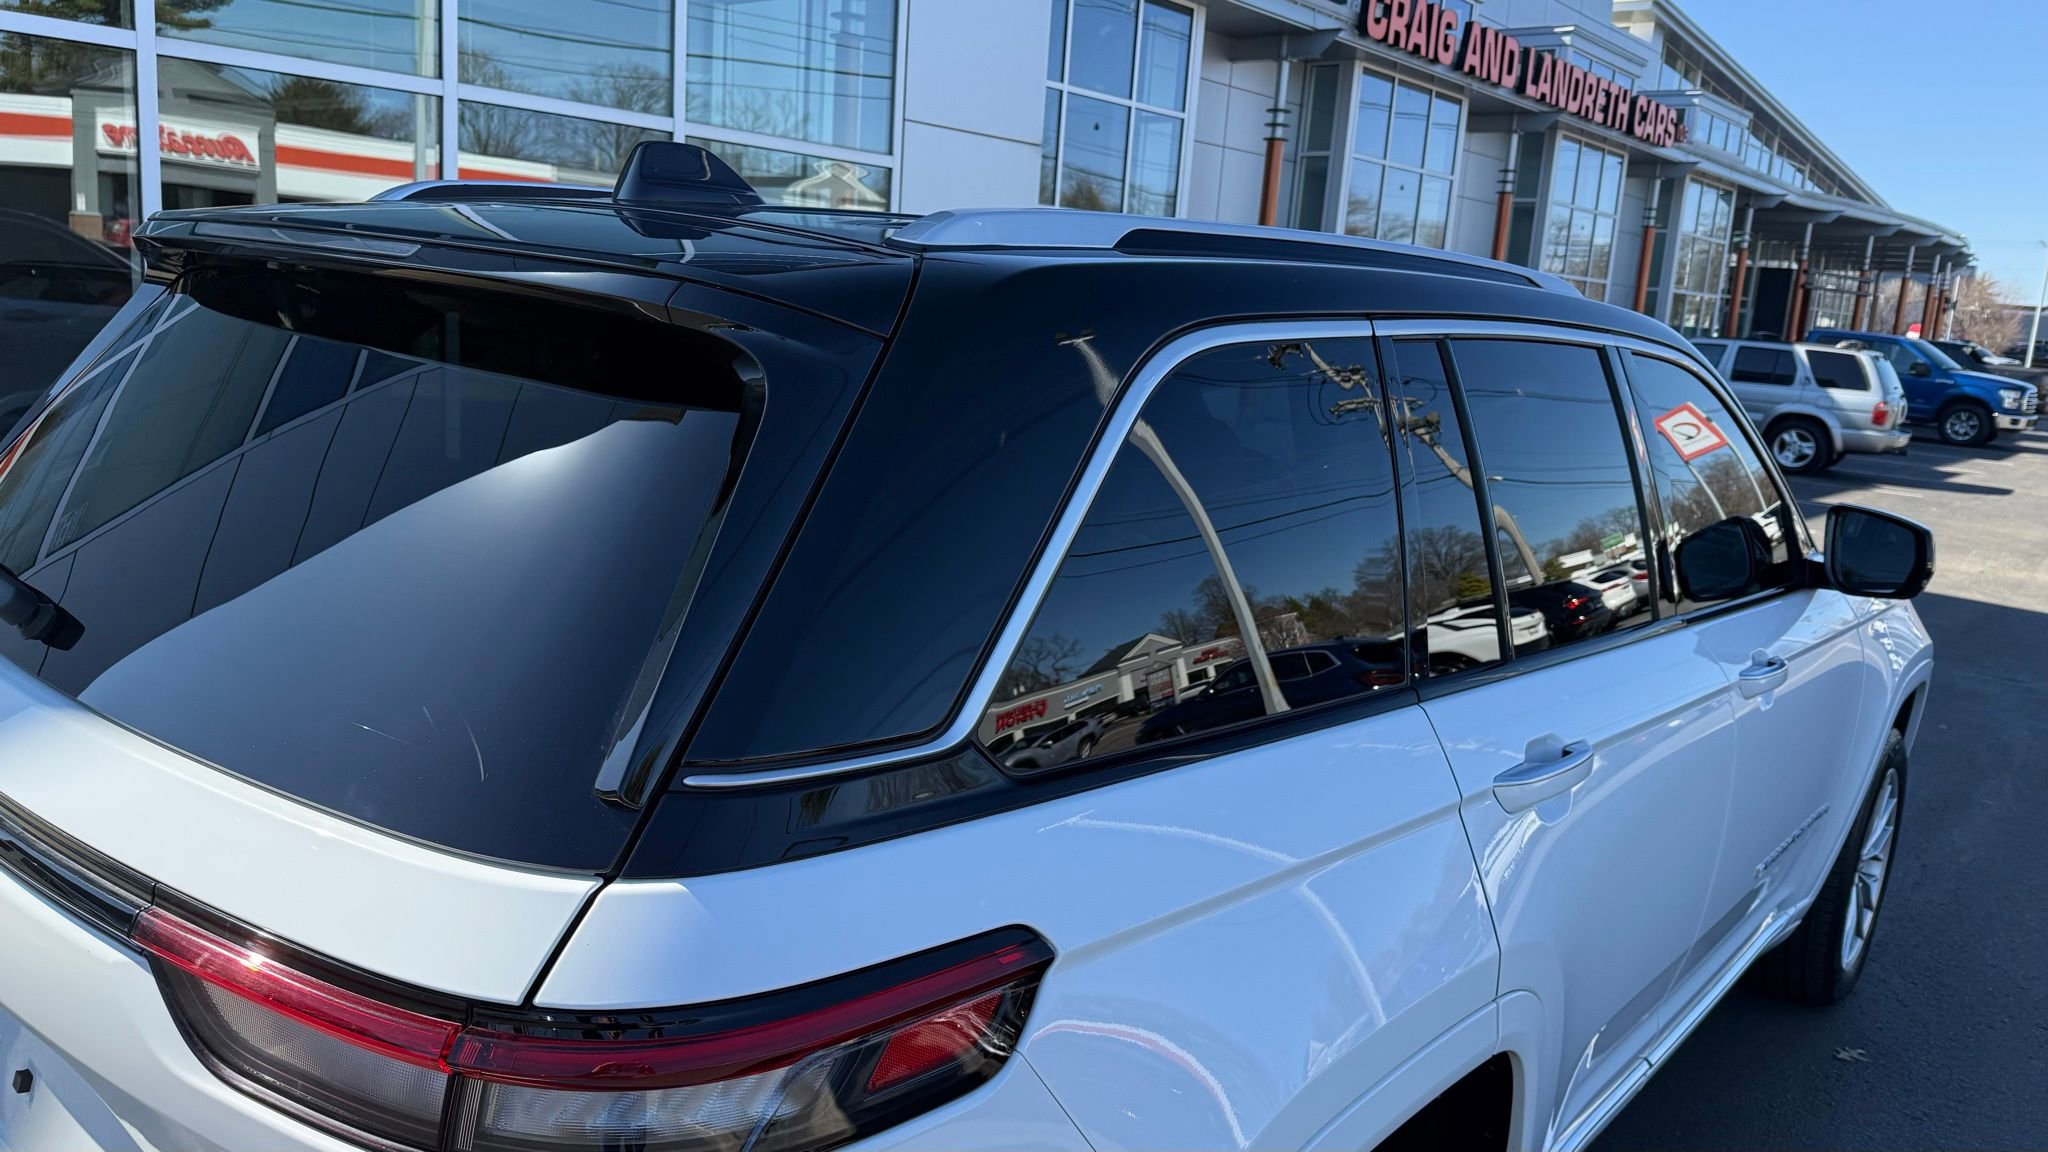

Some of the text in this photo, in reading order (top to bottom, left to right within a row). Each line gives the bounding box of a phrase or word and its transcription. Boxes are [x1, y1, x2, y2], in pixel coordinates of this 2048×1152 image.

[1366, 0, 1678, 148] CRAIG AND LANDRETH CARS
